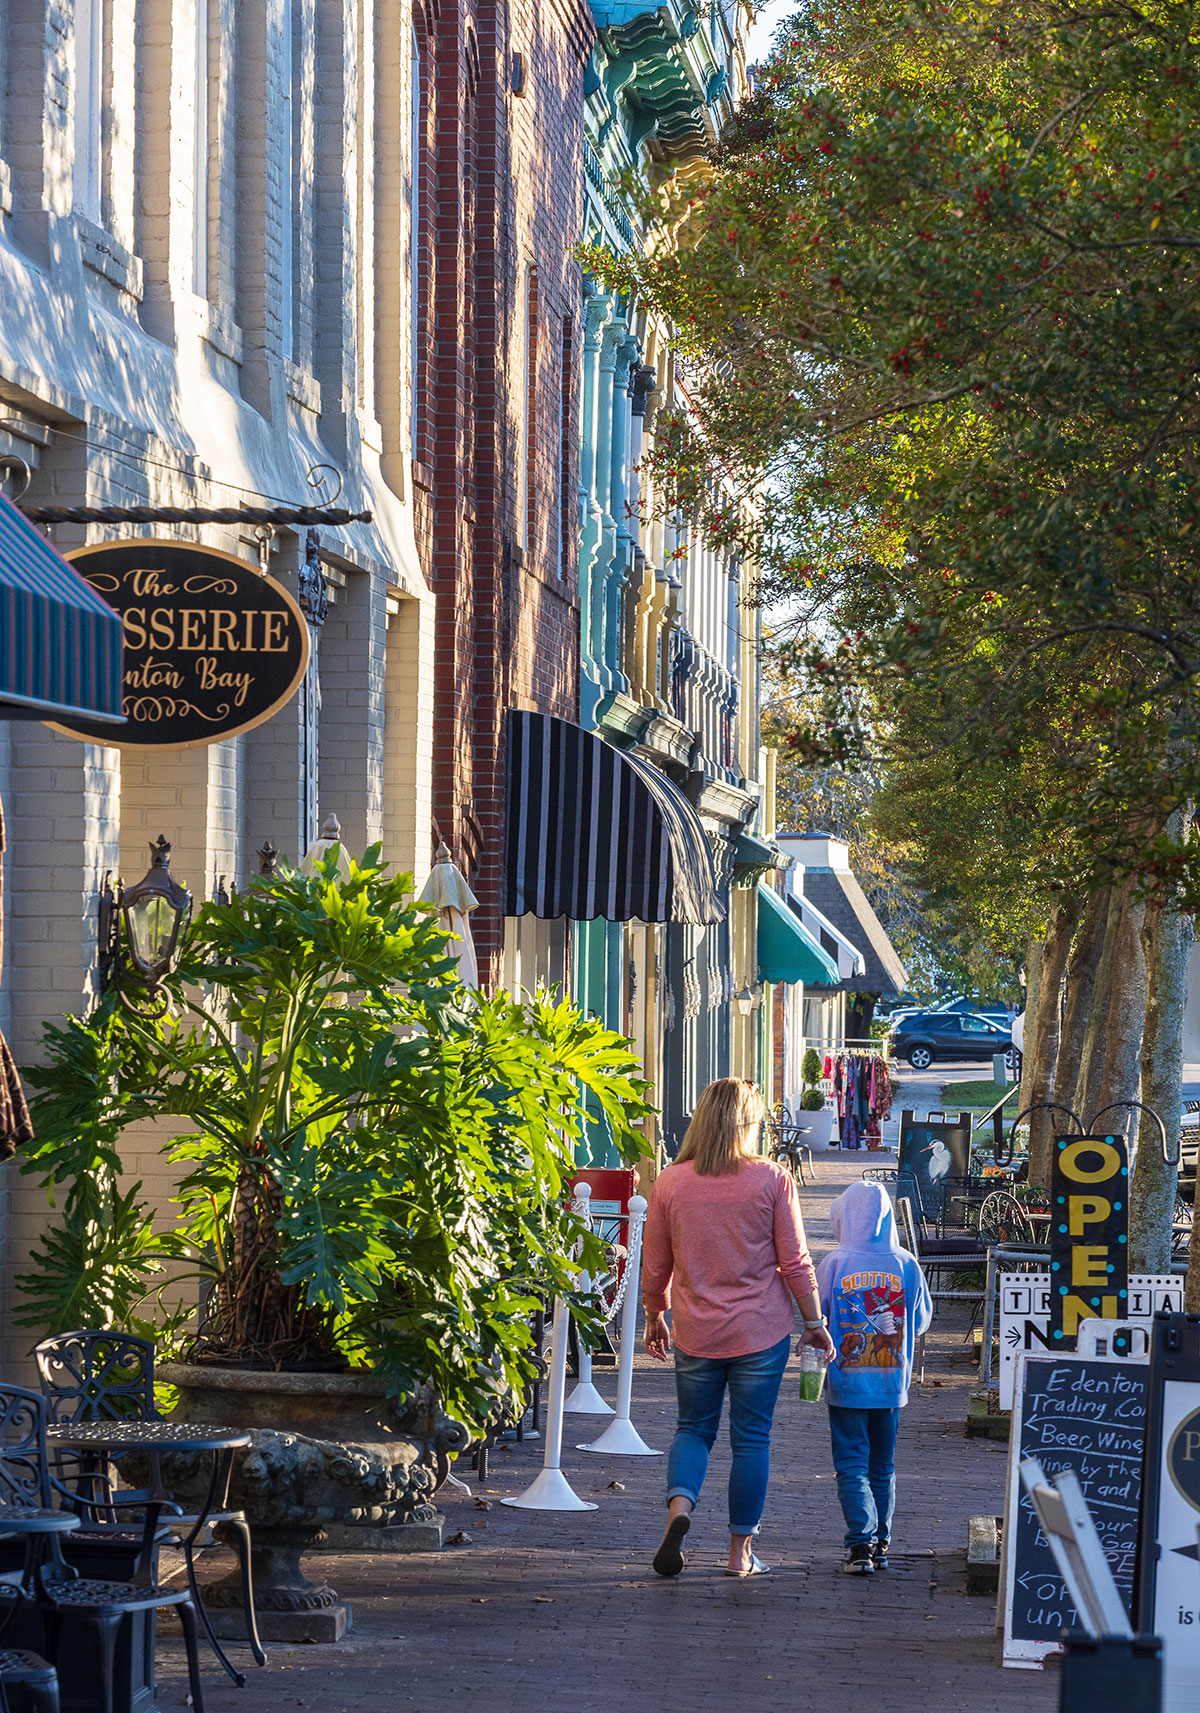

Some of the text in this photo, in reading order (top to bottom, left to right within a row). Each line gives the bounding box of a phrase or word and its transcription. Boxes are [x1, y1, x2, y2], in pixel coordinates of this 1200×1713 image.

[123, 569, 180, 597] The
[113, 607, 290, 653] SSERIE
[122, 656, 256, 707] nton Bay
[1058, 1140, 1121, 1336] OPEN
[841, 1271, 901, 1293] SCOTT'S
[1009, 1291, 1174, 1312] TRIA
[1046, 1369, 1145, 1394] Edenton
[1028, 1393, 1147, 1420] Trading Co
[1041, 1424, 1093, 1451] Beer,
[1080, 1457, 1102, 1479] by
[1097, 1481, 1132, 1499] and
[1178, 1606, 1194, 1625] is
